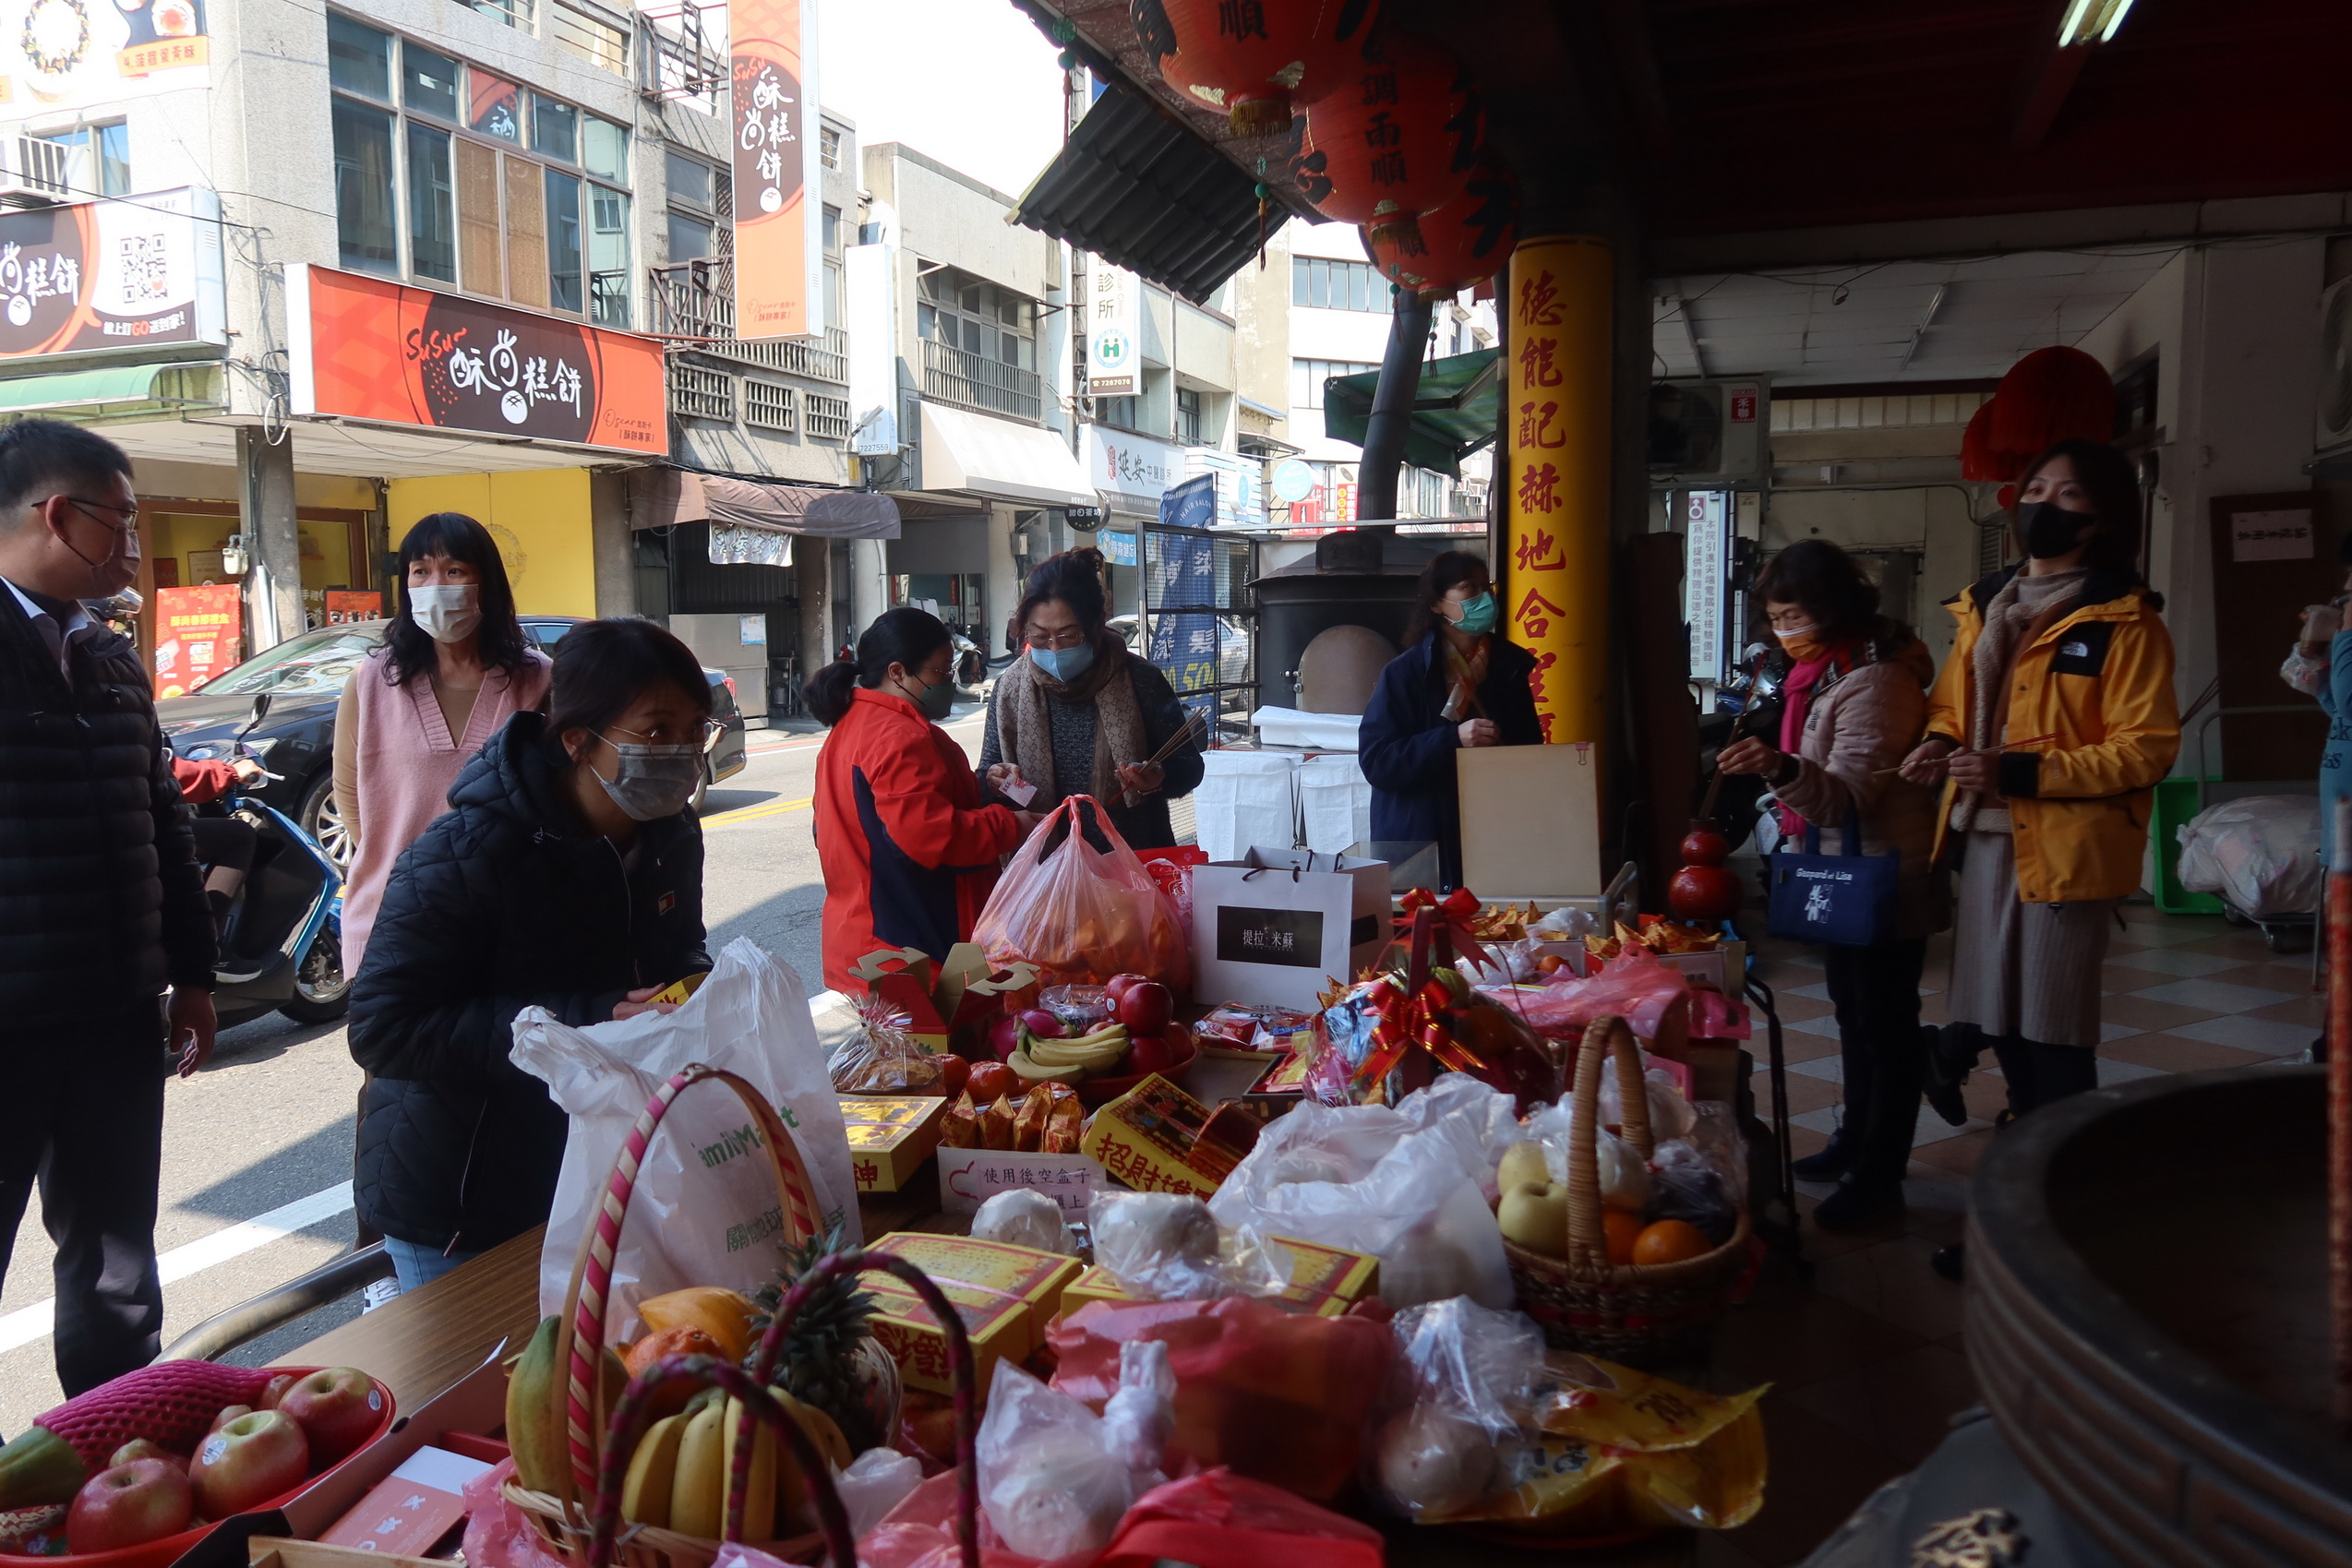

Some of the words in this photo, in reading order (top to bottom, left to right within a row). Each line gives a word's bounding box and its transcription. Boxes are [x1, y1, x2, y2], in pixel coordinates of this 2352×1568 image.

[1795, 868, 1827, 880] Gaspard
[983, 1167, 1091, 1185] 使用後空盒子
